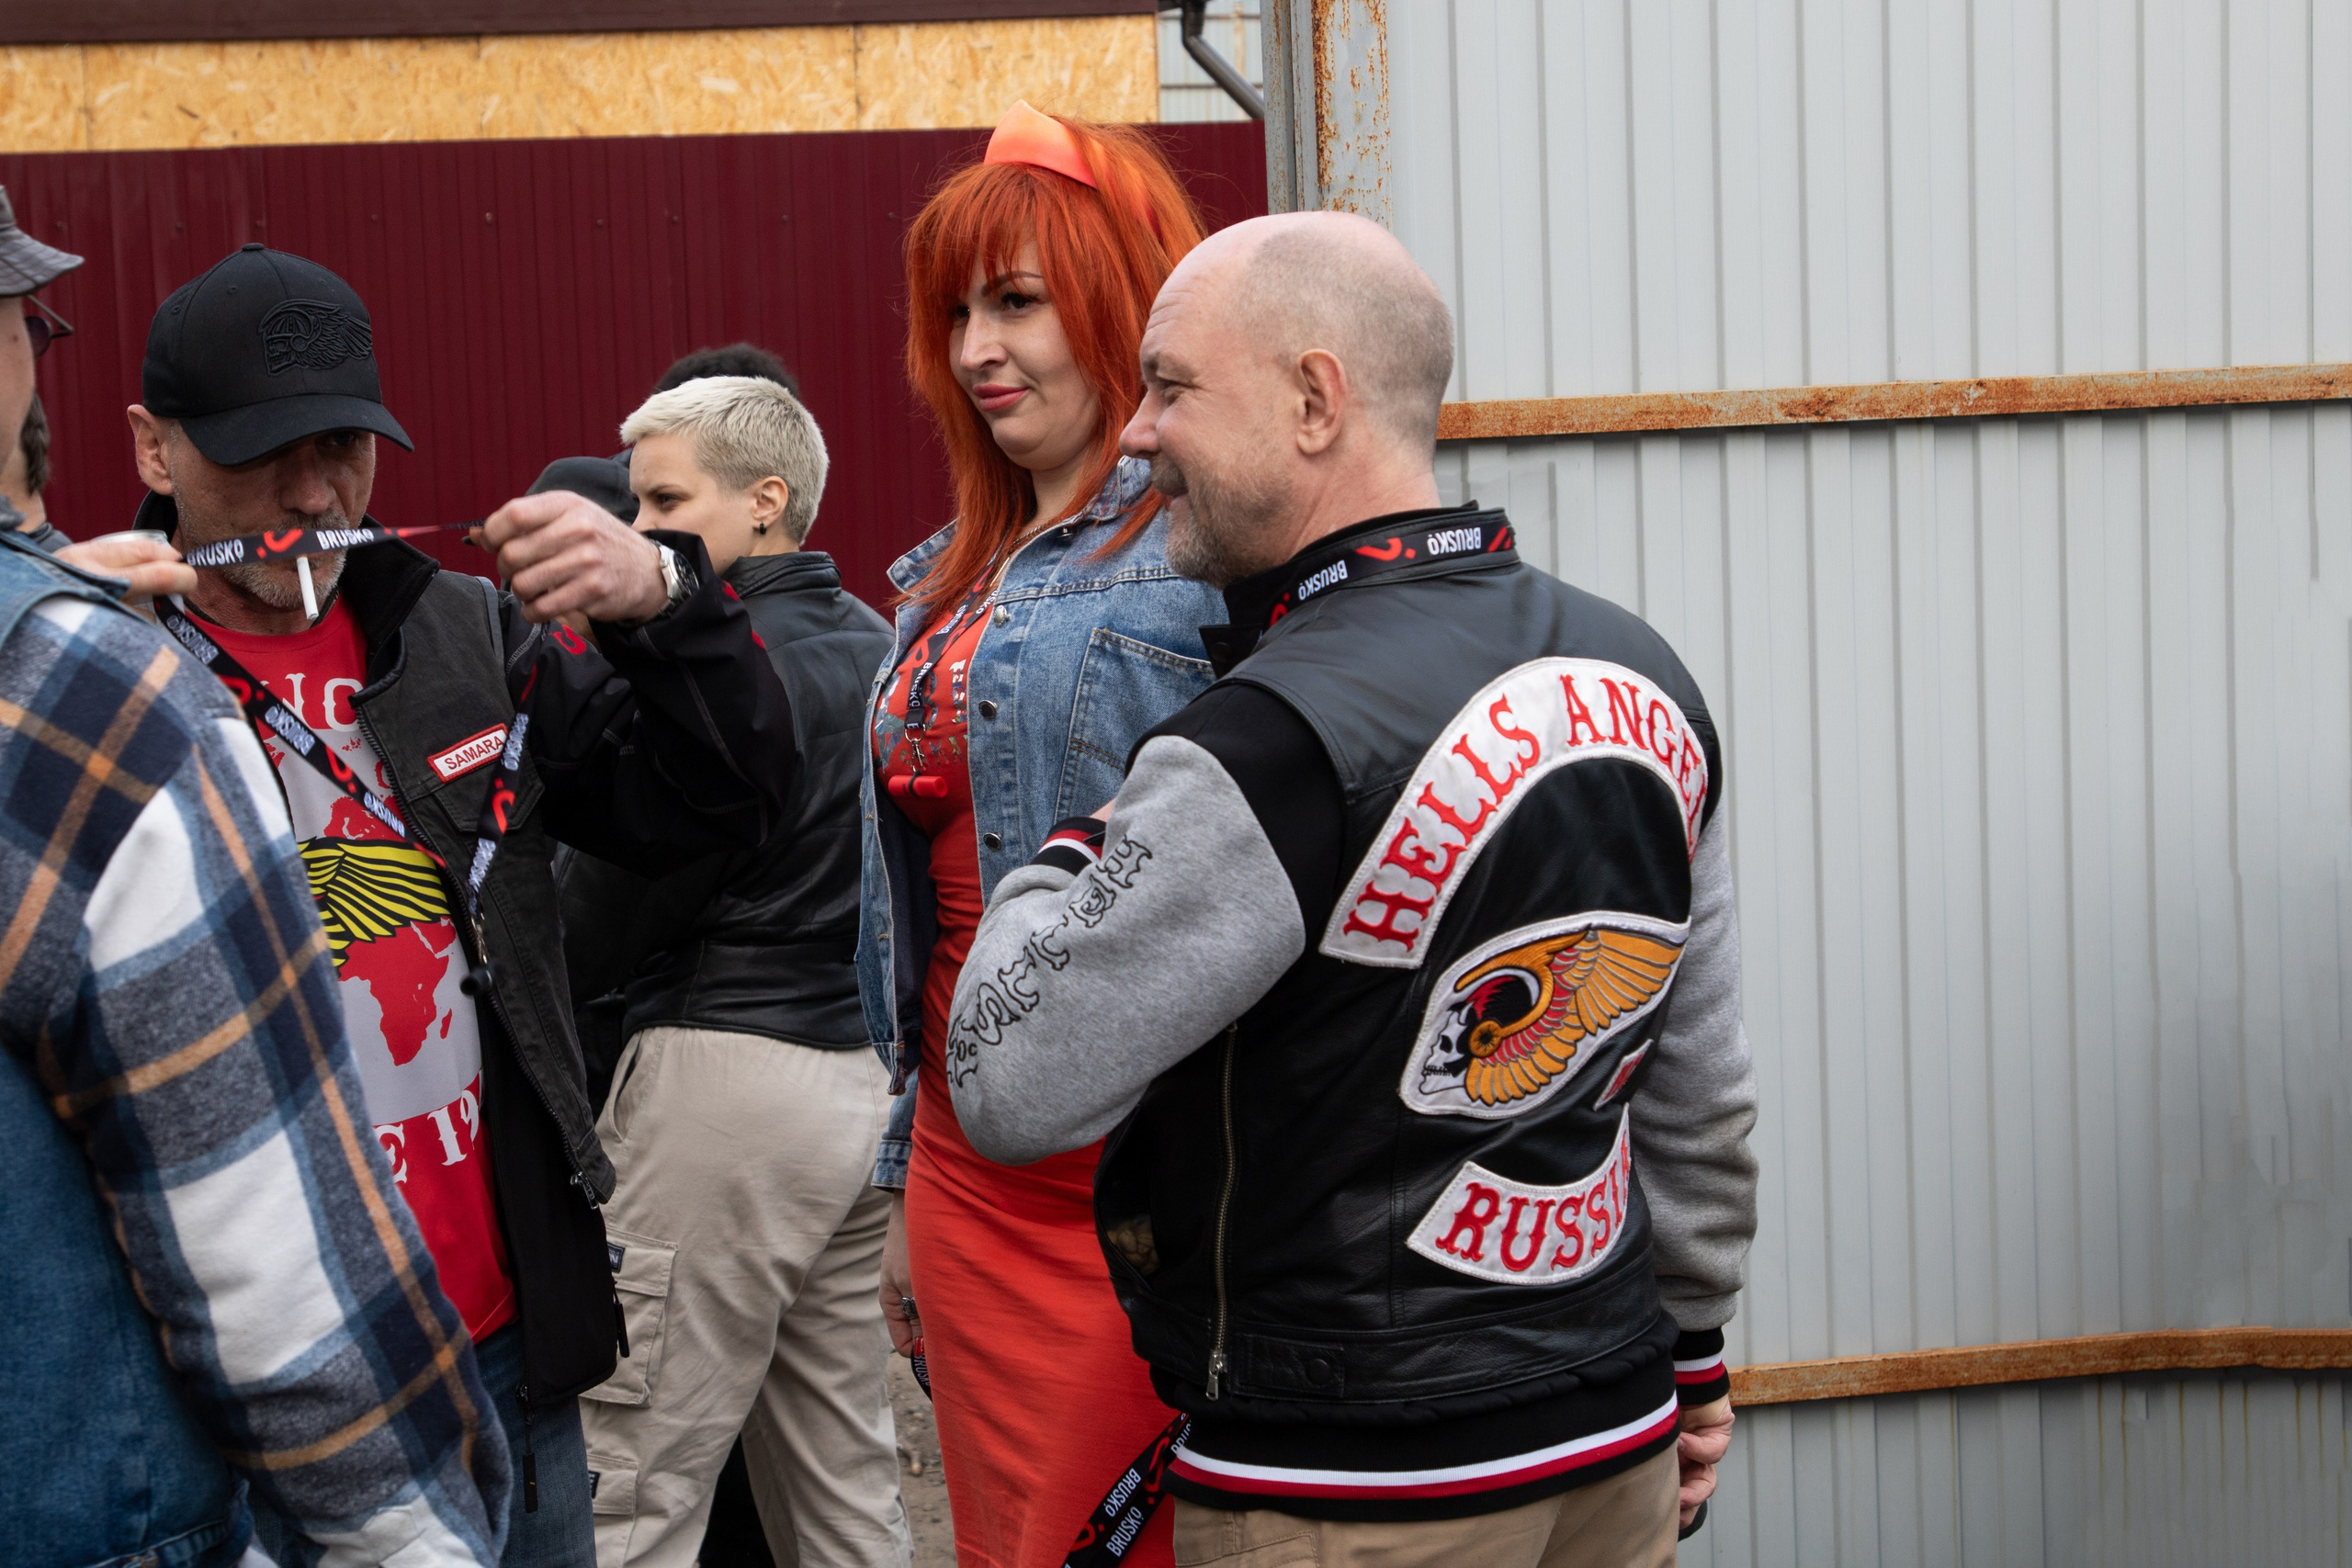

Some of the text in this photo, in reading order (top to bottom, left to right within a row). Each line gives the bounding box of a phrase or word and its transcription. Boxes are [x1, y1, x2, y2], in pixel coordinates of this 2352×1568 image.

[445, 736, 504, 771] SAMARA
[1343, 674, 1708, 953] HELLS ANGEL
